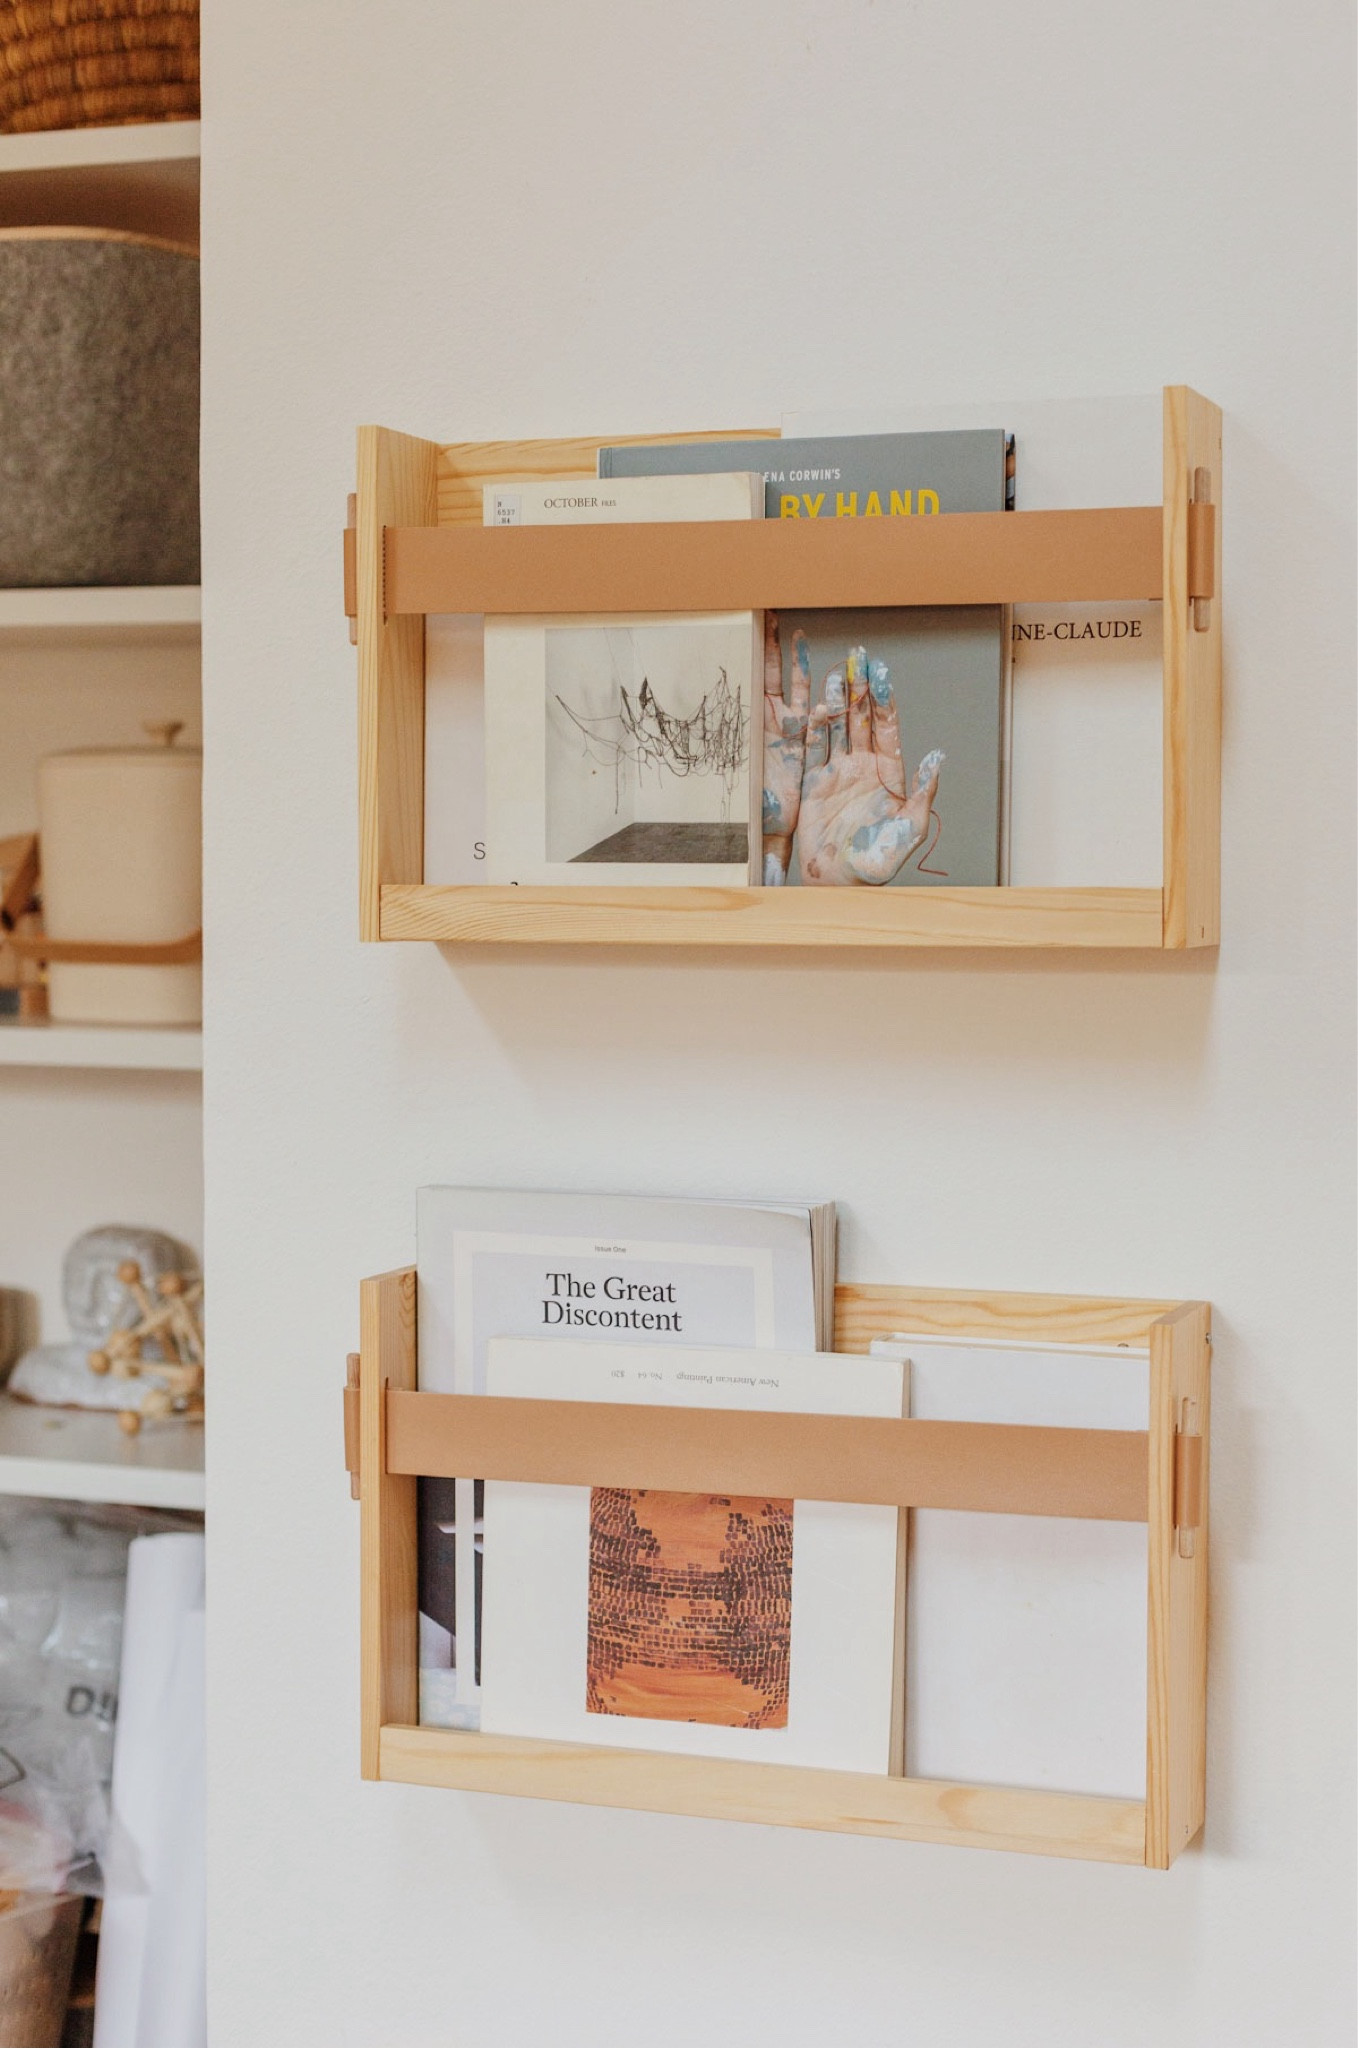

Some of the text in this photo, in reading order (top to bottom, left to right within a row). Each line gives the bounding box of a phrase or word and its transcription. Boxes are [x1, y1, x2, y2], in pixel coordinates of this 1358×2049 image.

[763, 468, 841, 483] ENA CORWIN'S
[543, 497, 598, 509] OCTOBER
[780, 489, 940, 519] BY HAND
[545, 1273, 676, 1303] The Great
[541, 1300, 683, 1332] Discontent
[715, 1375, 757, 1386] American
[759, 1378, 780, 1388] New
